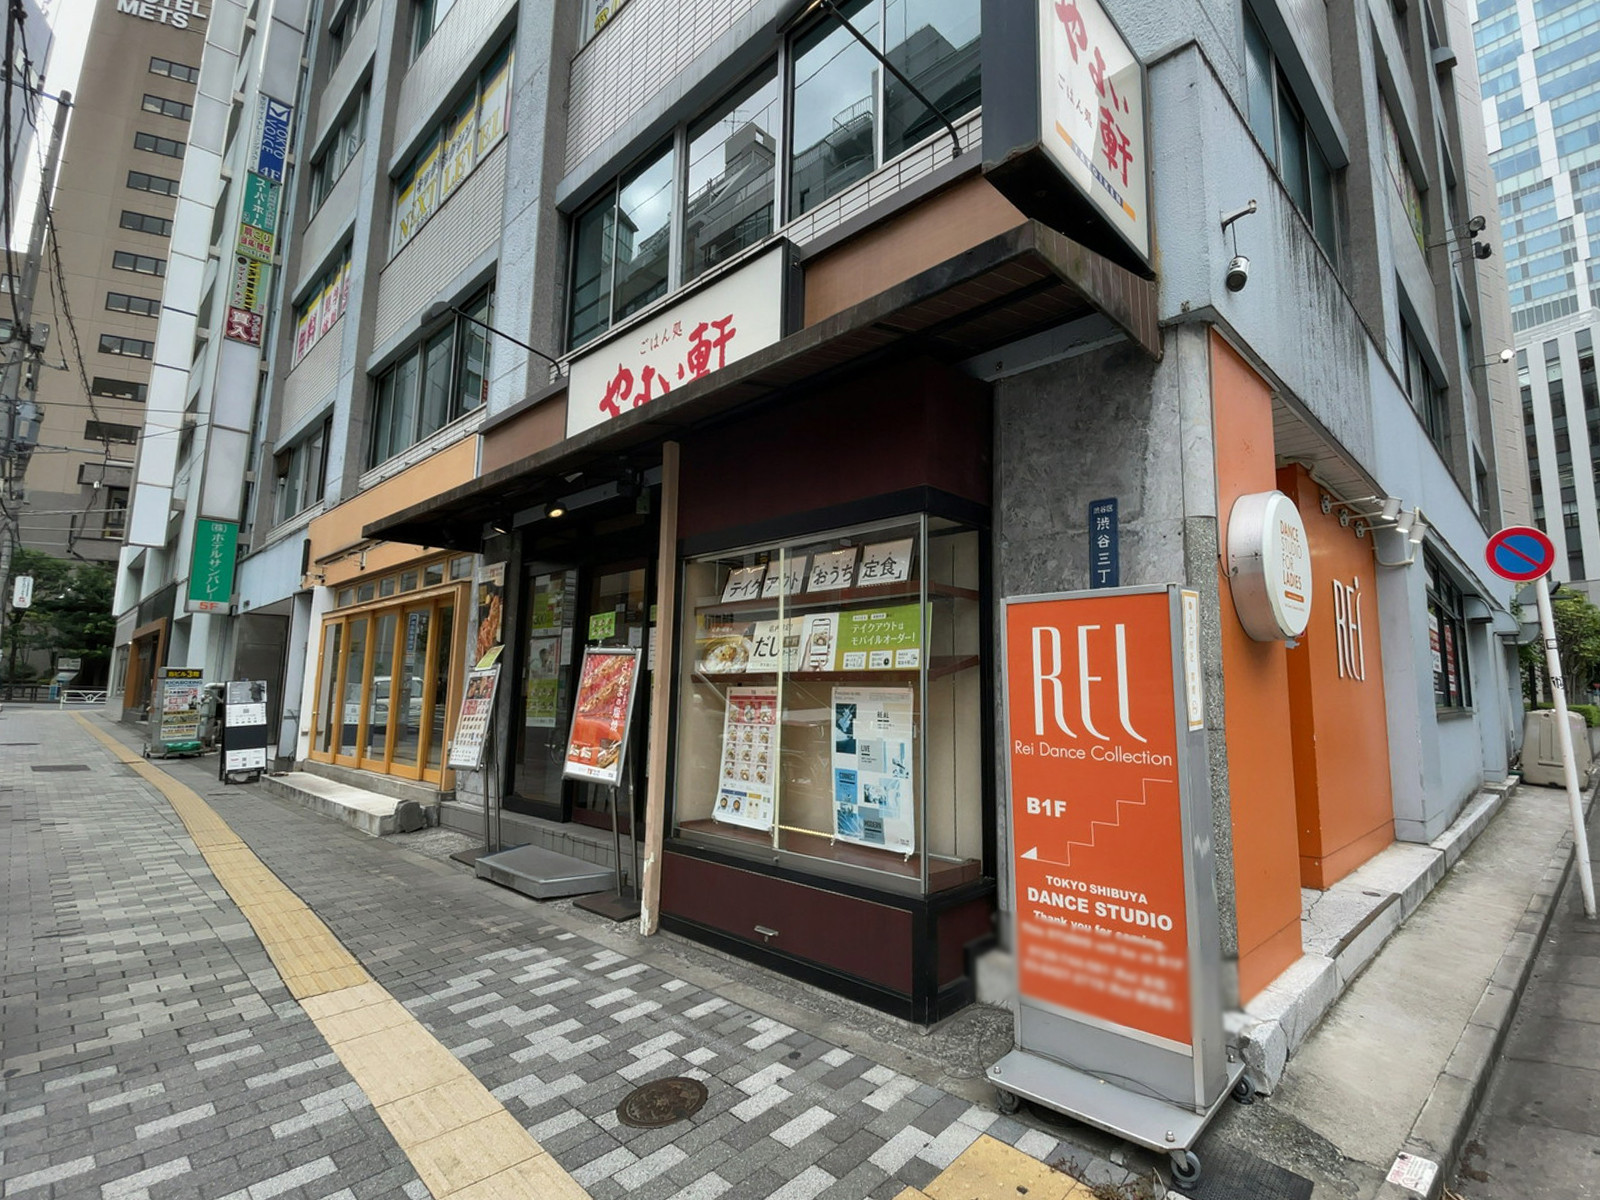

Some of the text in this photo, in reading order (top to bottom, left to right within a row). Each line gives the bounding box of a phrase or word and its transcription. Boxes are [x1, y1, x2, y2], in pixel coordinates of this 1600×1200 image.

[116, 0, 189, 29] METS
[262, 117, 278, 154] VOICE
[273, 121, 288, 160] TOKYO
[260, 166, 281, 180] 4F
[639, 320, 683, 355] ごはん処
[1280, 519, 1299, 543] DANCE
[1096, 516, 1111, 584] 渋谷三丁
[1281, 536, 1302, 560] STUDIO
[1282, 552, 1294, 571] FOR
[1283, 569, 1302, 590] LADIES
[199, 601, 220, 611] 5F
[851, 621, 905, 635] テイクアウトは
[851, 632, 916, 646] モバイルオーダー!
[753, 636, 779, 658] だし
[877, 711, 890, 719] REAL
[1014, 740, 1173, 767] Rei Dance Collection
[1026, 796, 1067, 818] B1F
[1045, 875, 1148, 905] TOKYO SHIBUYA
[1027, 887, 1173, 932] DANCE STUDIO
[1033, 910, 1067, 926] Thank
[1070, 920, 1092, 933] you
[1094, 924, 1112, 937] for
